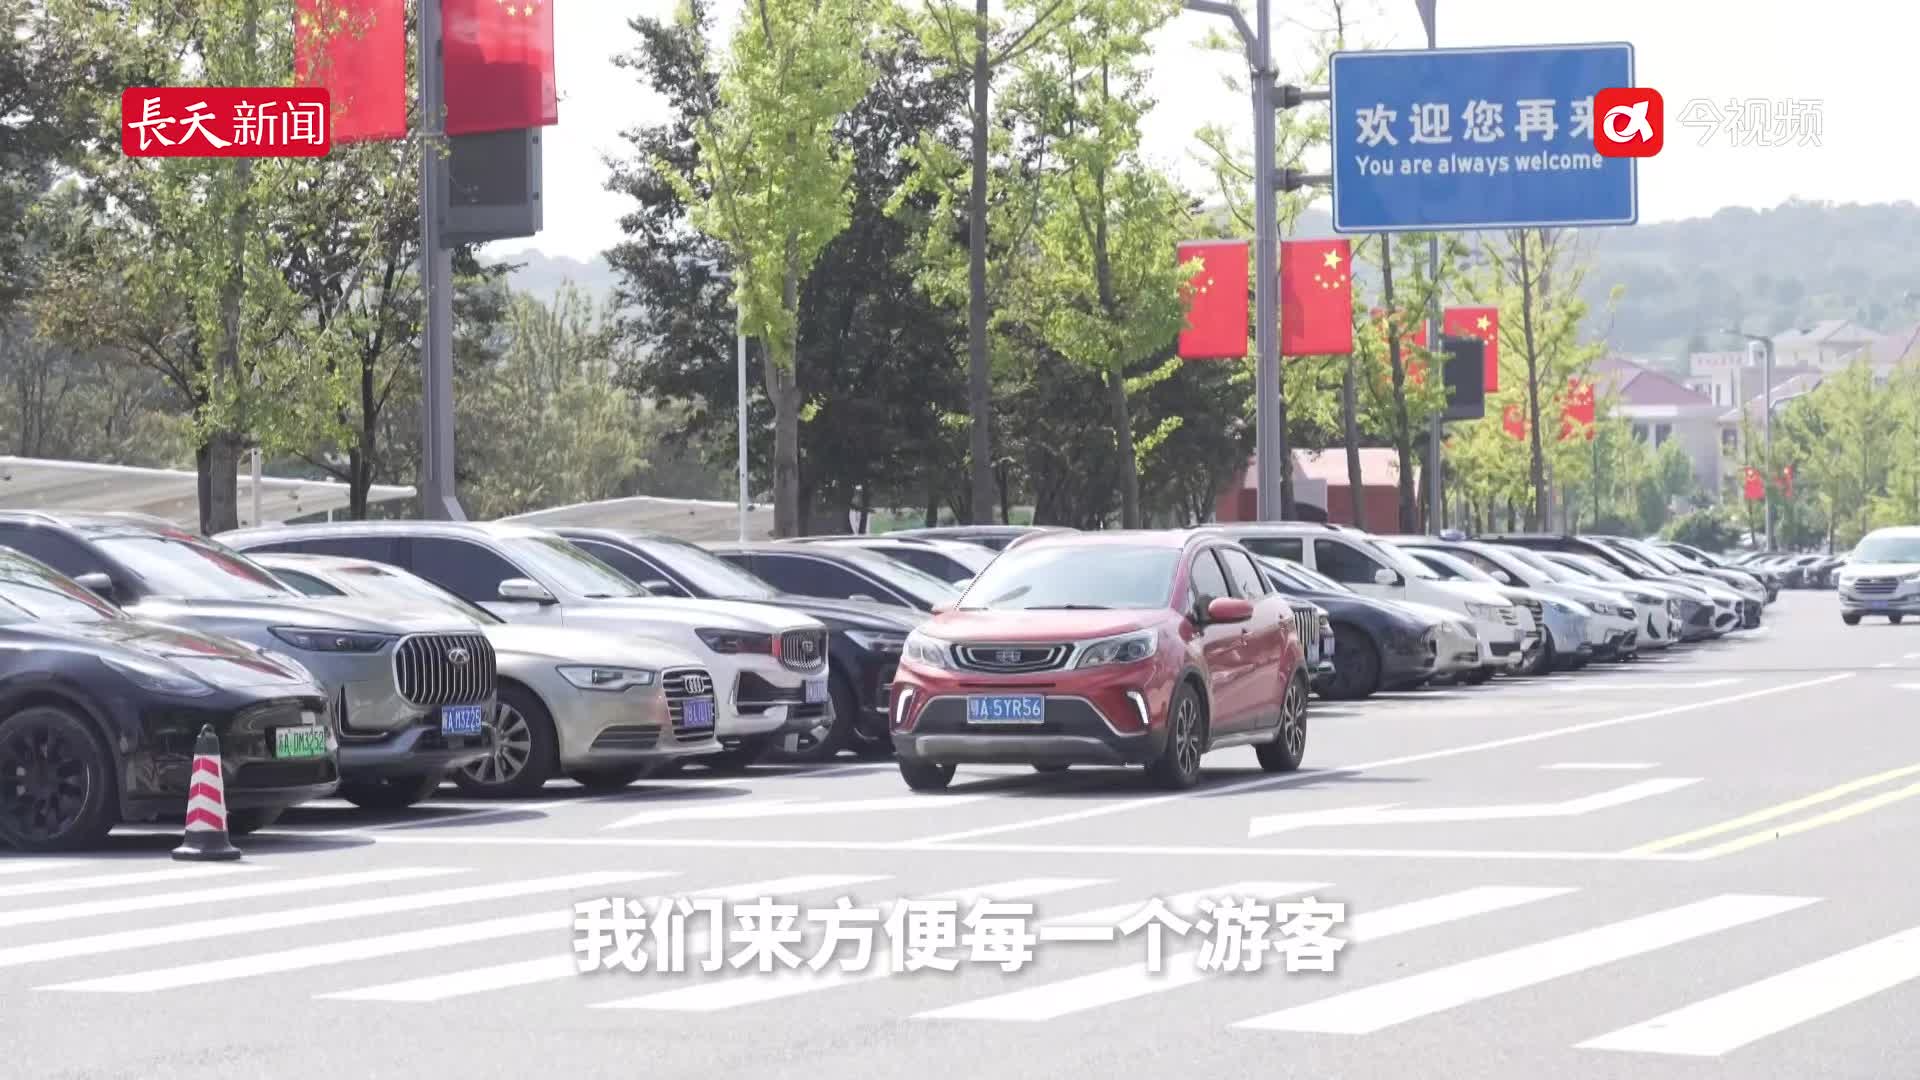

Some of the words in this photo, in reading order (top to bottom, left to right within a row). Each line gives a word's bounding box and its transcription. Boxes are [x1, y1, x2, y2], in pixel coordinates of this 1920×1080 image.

[1355, 155, 1394, 176] You
[1400, 157, 1433, 175] are
[1438, 152, 1509, 176] always
[1515, 150, 1603, 171] welcome
